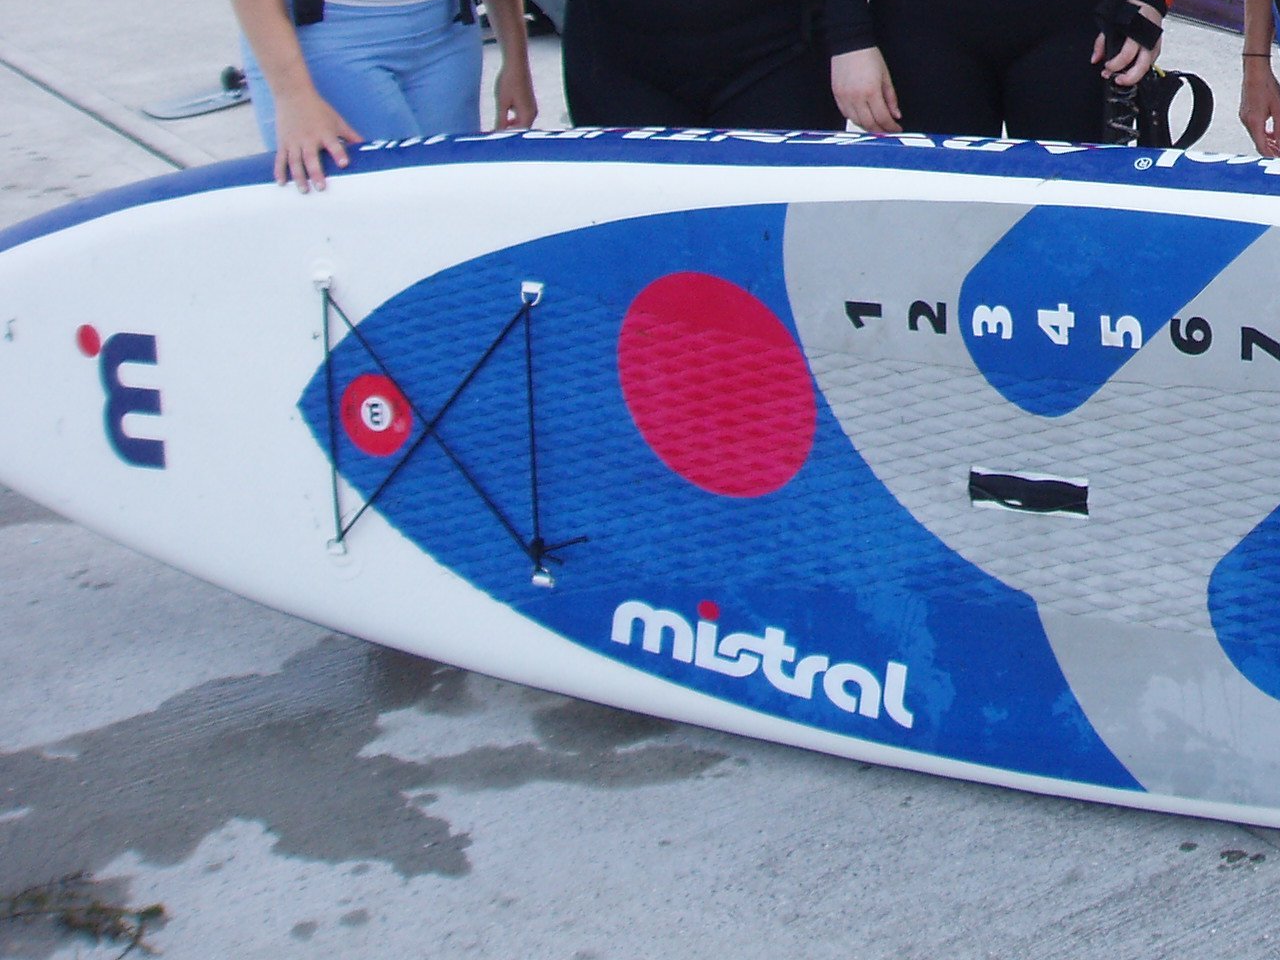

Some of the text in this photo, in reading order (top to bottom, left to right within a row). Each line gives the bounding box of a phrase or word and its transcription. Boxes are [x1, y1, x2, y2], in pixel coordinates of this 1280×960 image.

[844, 300, 882, 330] 1
[908, 300, 947, 334] 2
[972, 304, 1013, 340] 3
[1037, 303, 1075, 345] 4
[1100, 314, 1143, 350] 5
[1170, 316, 1213, 356] 6
[610, 599, 914, 729] mistral
